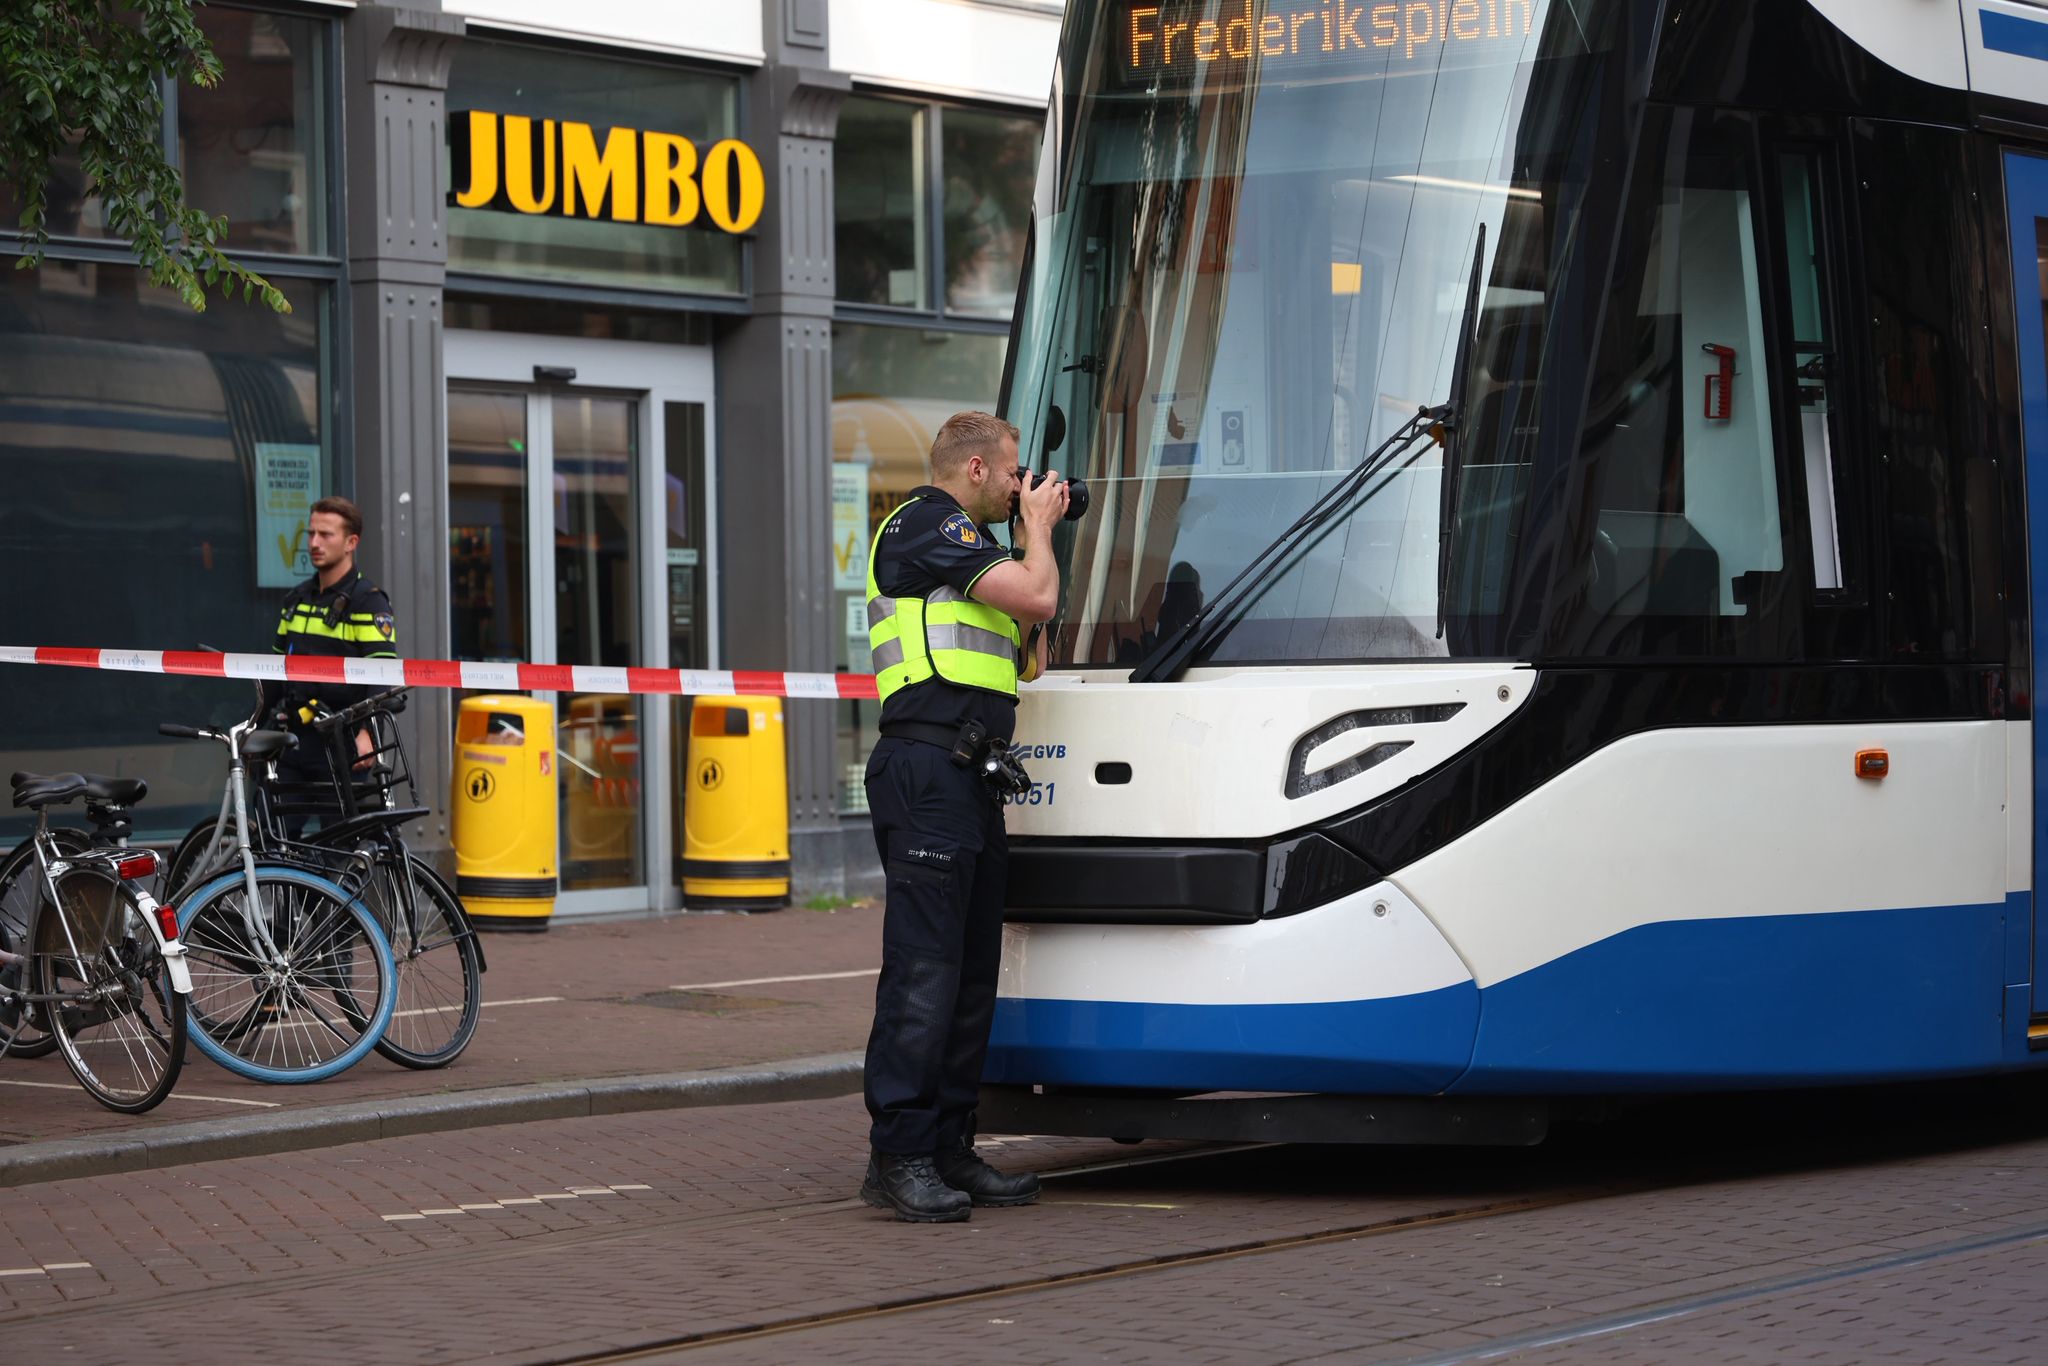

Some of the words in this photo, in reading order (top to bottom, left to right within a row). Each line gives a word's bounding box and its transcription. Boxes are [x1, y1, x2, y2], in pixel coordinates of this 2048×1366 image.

[1131, 0, 1531, 66] Frederiksplein
[456, 110, 766, 234] JUMBO
[1033, 744, 1067, 759] GVB
